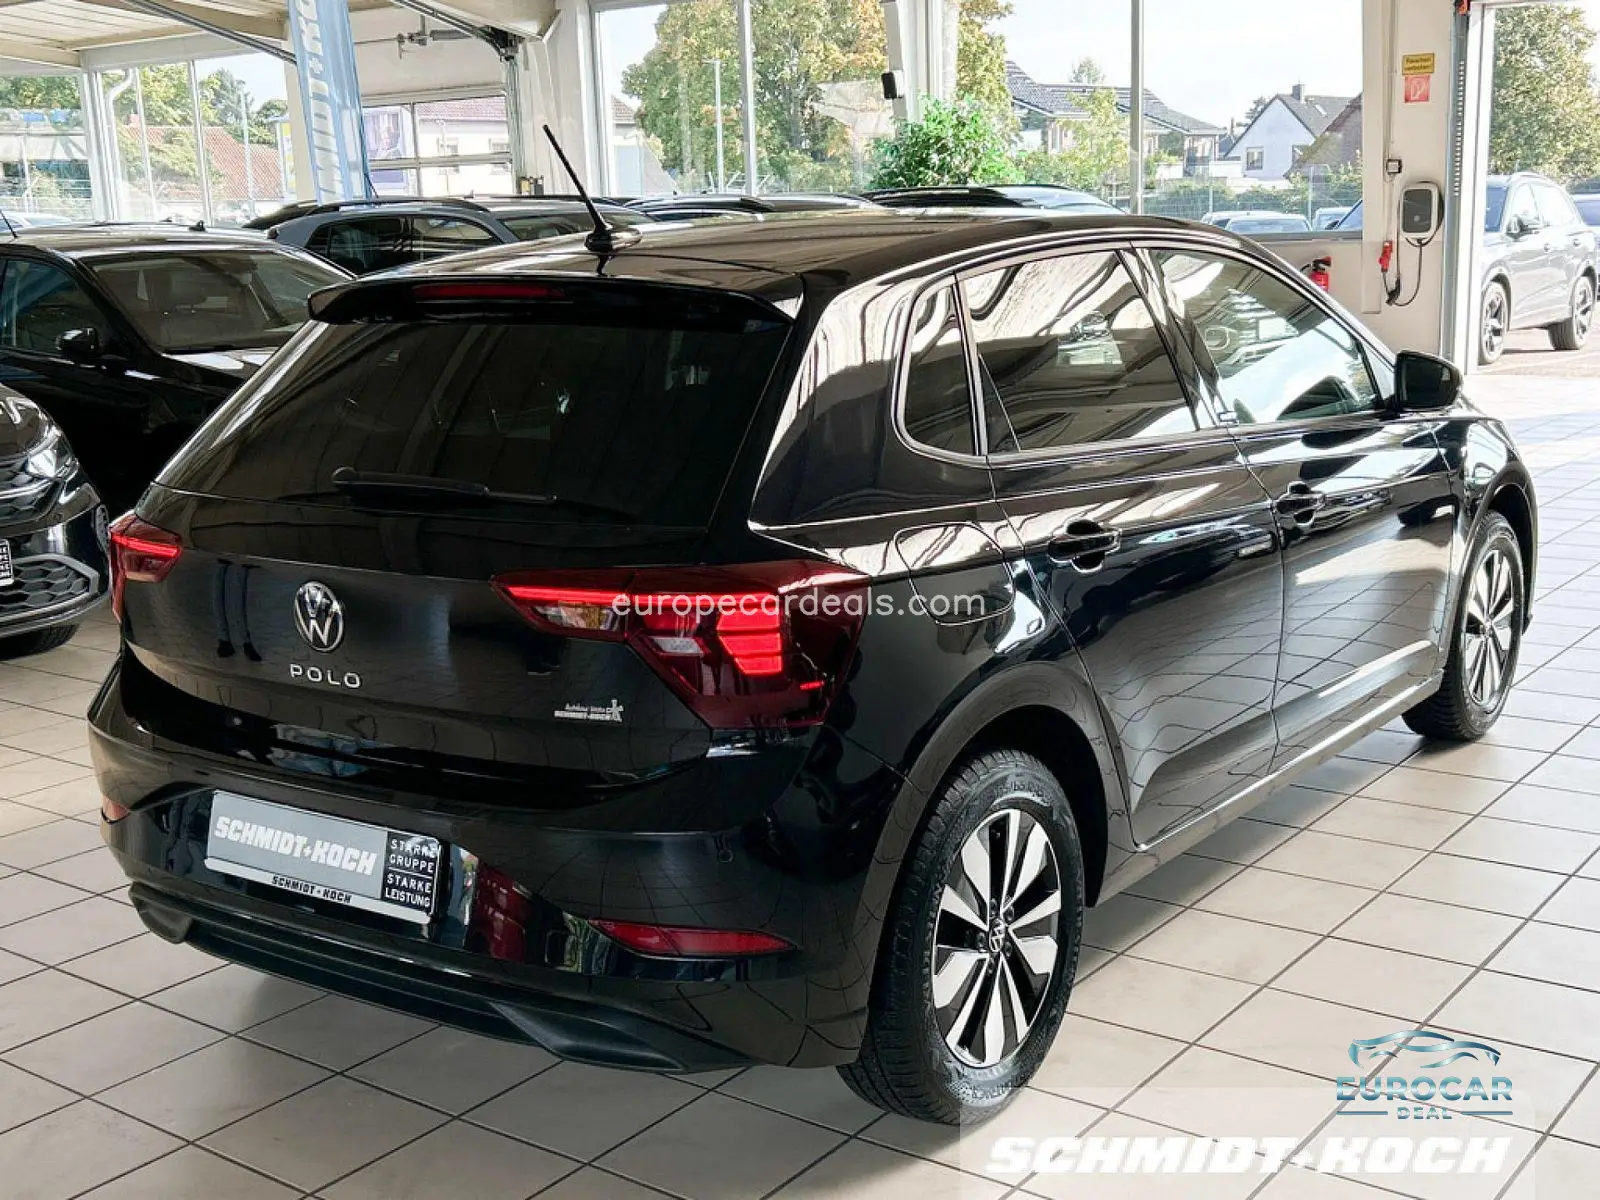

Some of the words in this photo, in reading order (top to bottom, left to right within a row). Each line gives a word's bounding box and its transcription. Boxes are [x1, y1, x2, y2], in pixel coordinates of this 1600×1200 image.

[290, 663, 362, 689] POLO
[389, 854, 435, 873] GRUPPE
[387, 872, 432, 893] STARKE
[385, 887, 430, 907] LEISTUNG
